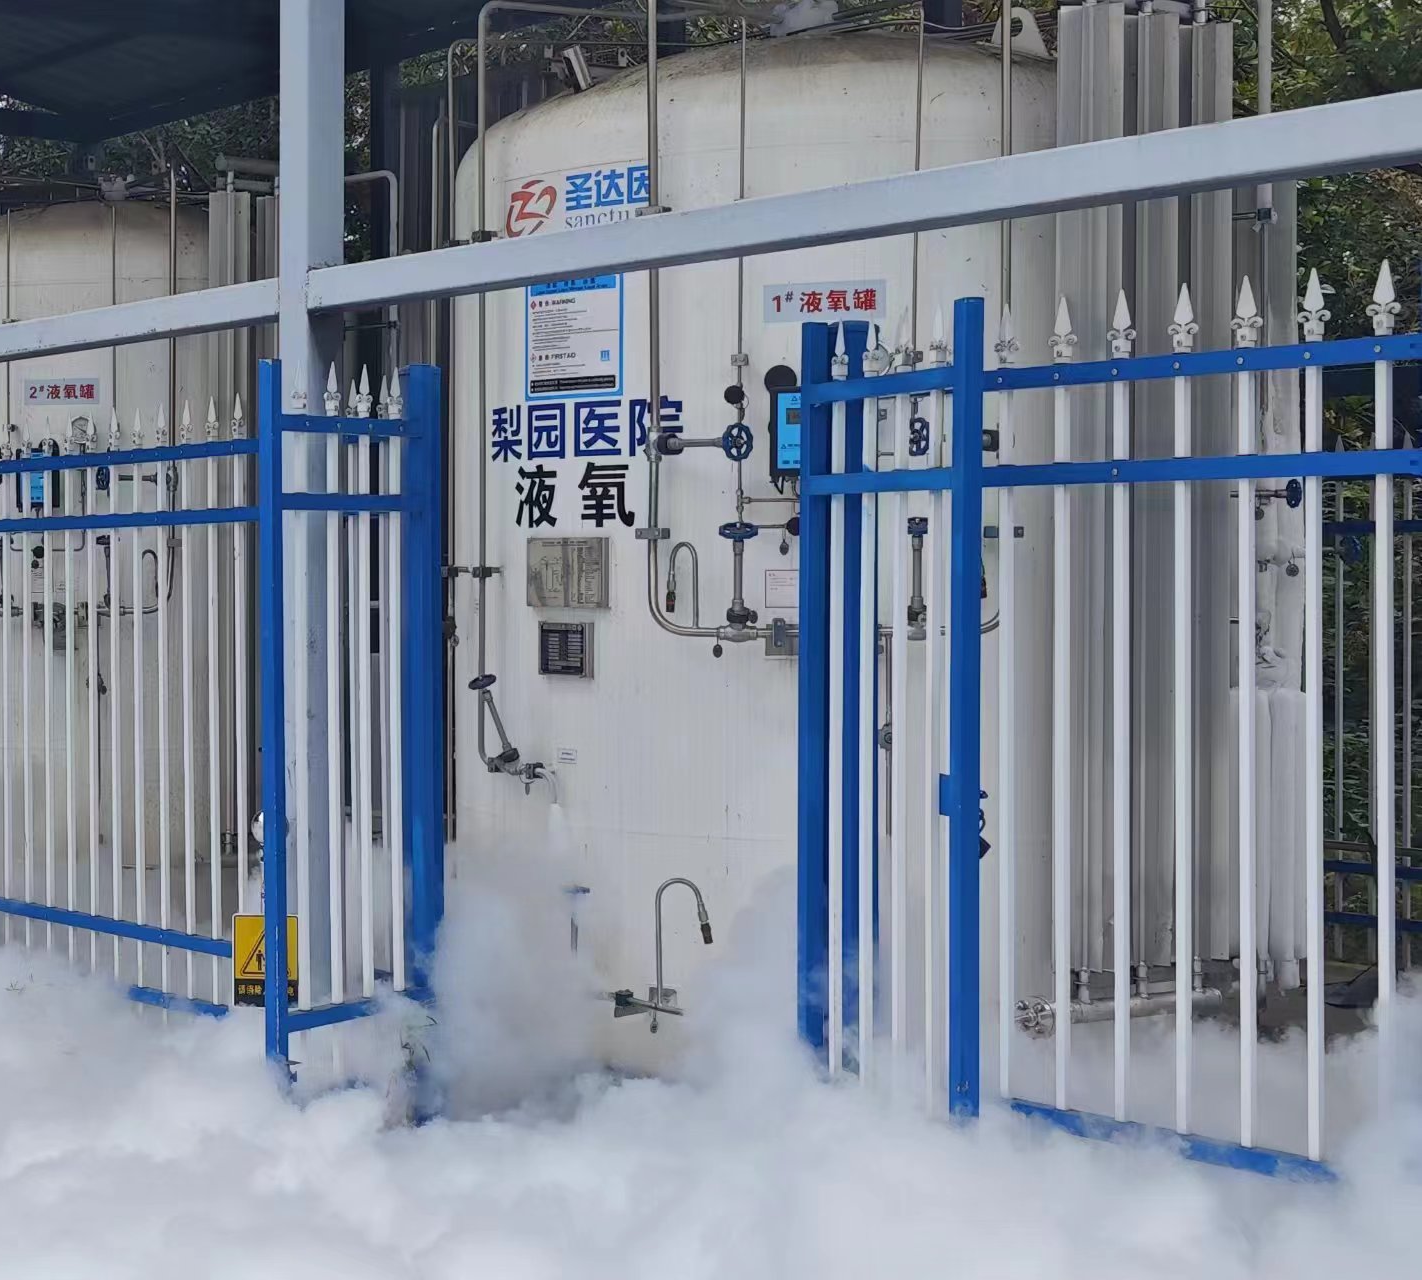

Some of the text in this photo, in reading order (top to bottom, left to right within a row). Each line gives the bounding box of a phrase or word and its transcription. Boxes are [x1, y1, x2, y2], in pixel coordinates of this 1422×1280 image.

[565, 165, 649, 212] 圣达因
[491, 395, 683, 462] 梨园医院
[515, 462, 636, 529] 液氧
